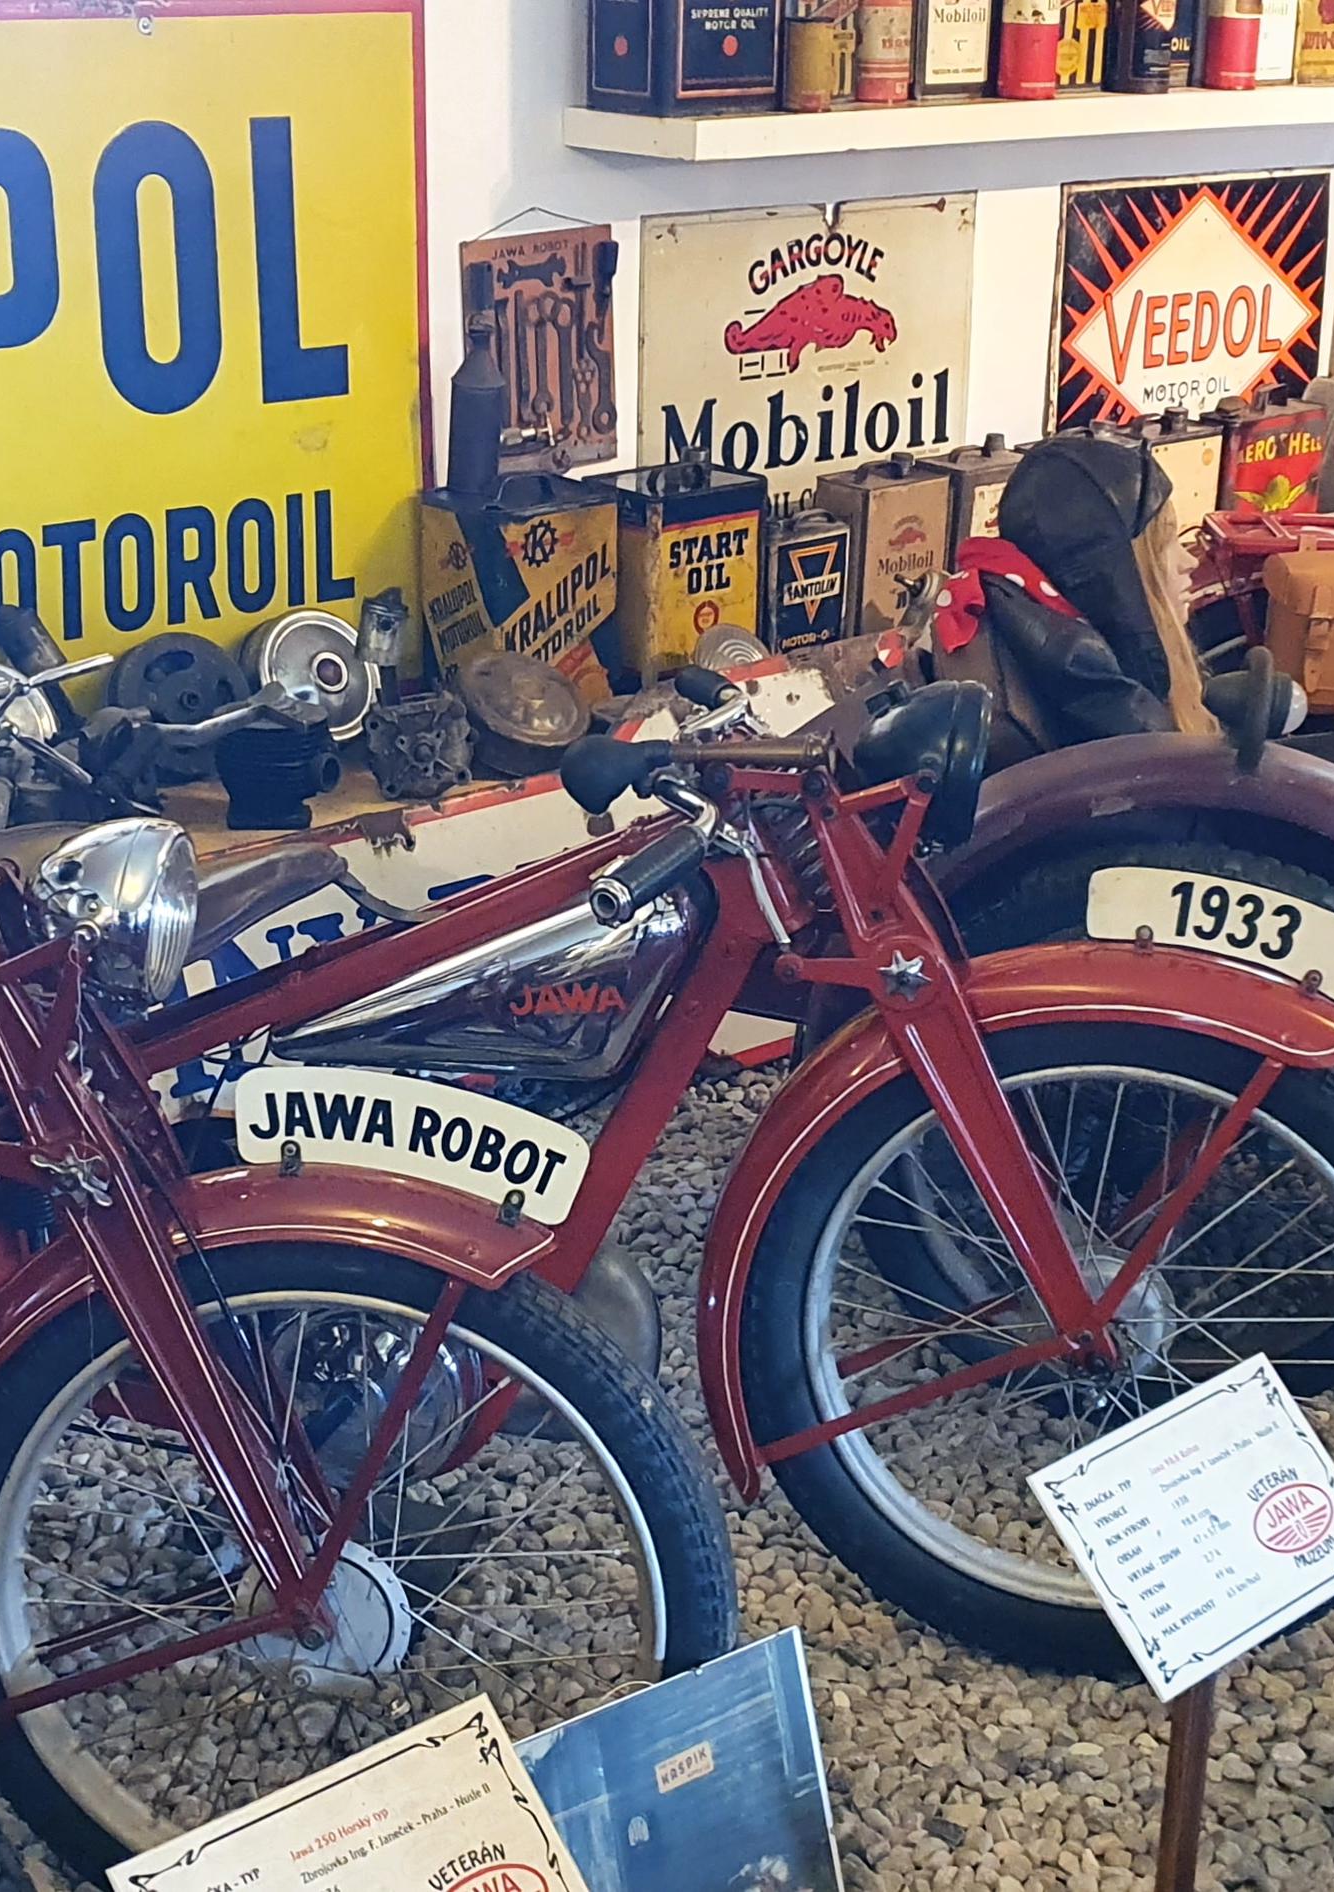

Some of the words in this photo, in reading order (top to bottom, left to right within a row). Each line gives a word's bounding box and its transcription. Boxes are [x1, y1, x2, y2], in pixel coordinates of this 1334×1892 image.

[705, 20, 737, 30] MOTOR
[741, 19, 756, 29] OIL
[733, 7, 769, 18] QUALITY
[933, 7, 986, 24] Mobiloil
[1170, 37, 1190, 52] OIL
[748, 232, 885, 296] GARGOYLE
[1103, 283, 1283, 385] VEEDOL
[1142, 379, 1200, 403] MOTOR
[1205, 375, 1232, 396] OIL
[661, 368, 950, 474] Mobiloil
[669, 527, 749, 569] START
[877, 550, 935, 577] Mobiloil
[687, 563, 731, 596] OIL
[530, 592, 602, 665] OTOROIL
[1171, 881, 1302, 960] 1933
[509, 982, 627, 1017] JAWA
[249, 1091, 395, 1147] JAWA
[408, 1106, 567, 1196] ROBOT
[1246, 1465, 1299, 1503] VETERÁN
[1265, 1489, 1314, 1529] JAWA
[290, 1845, 314, 1861] Jawa
[315, 1832, 336, 1849] 250
[301, 1856, 348, 1884] Zbrojovka
[421, 1807, 448, 1824] Praha
[455, 1790, 481, 1808] Nusle
[239, 1868, 260, 1884] TYP
[428, 1841, 505, 1891] VETERÁN
